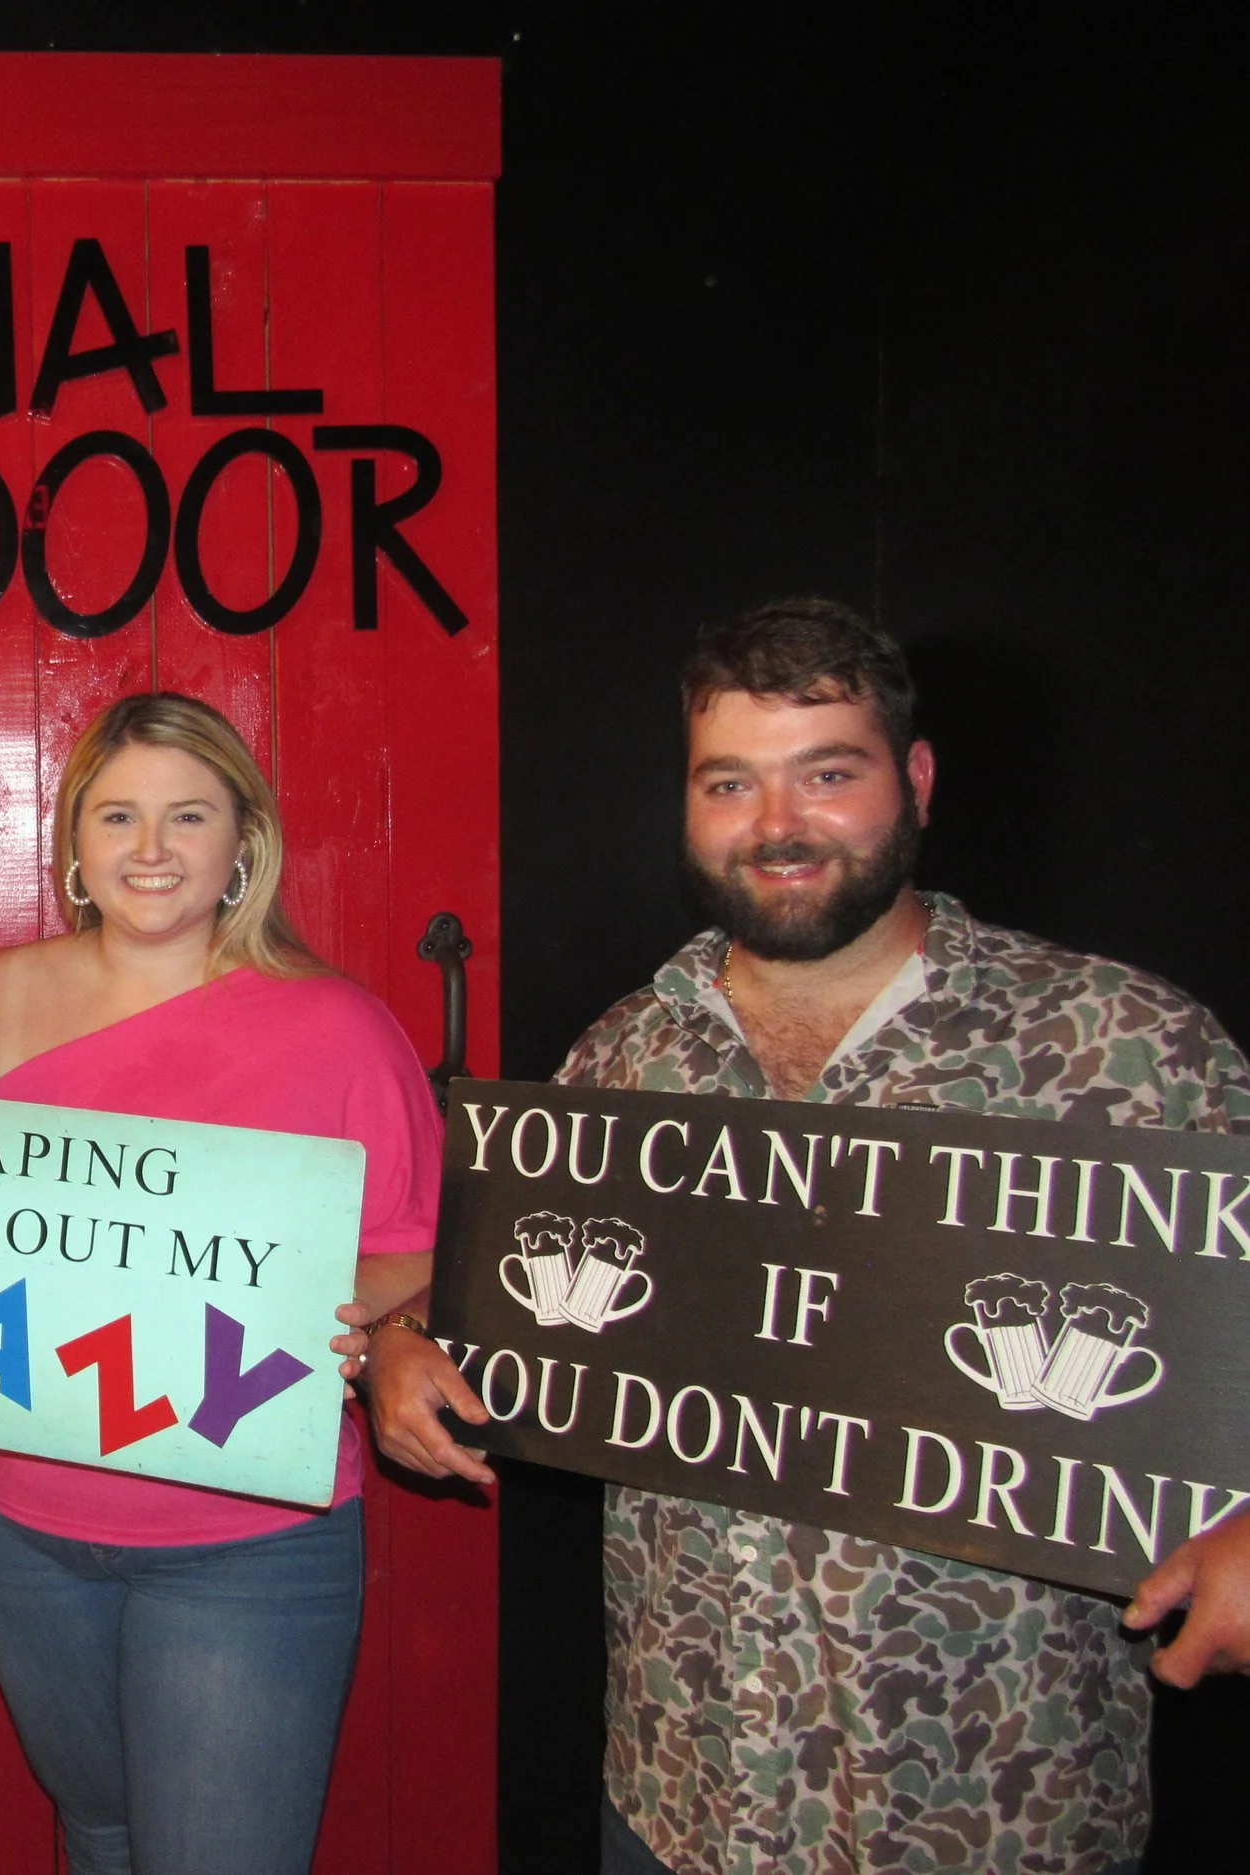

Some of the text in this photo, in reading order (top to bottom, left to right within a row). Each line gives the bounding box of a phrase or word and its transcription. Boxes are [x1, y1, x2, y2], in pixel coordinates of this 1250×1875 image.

[461, 1103, 1250, 1263] YOU CAN'T THINK
[6, 1208, 146, 1271] OUT
[167, 1229, 281, 1288] MY
[753, 1262, 840, 1347] IF
[603, 1370, 871, 1497] DON'T
